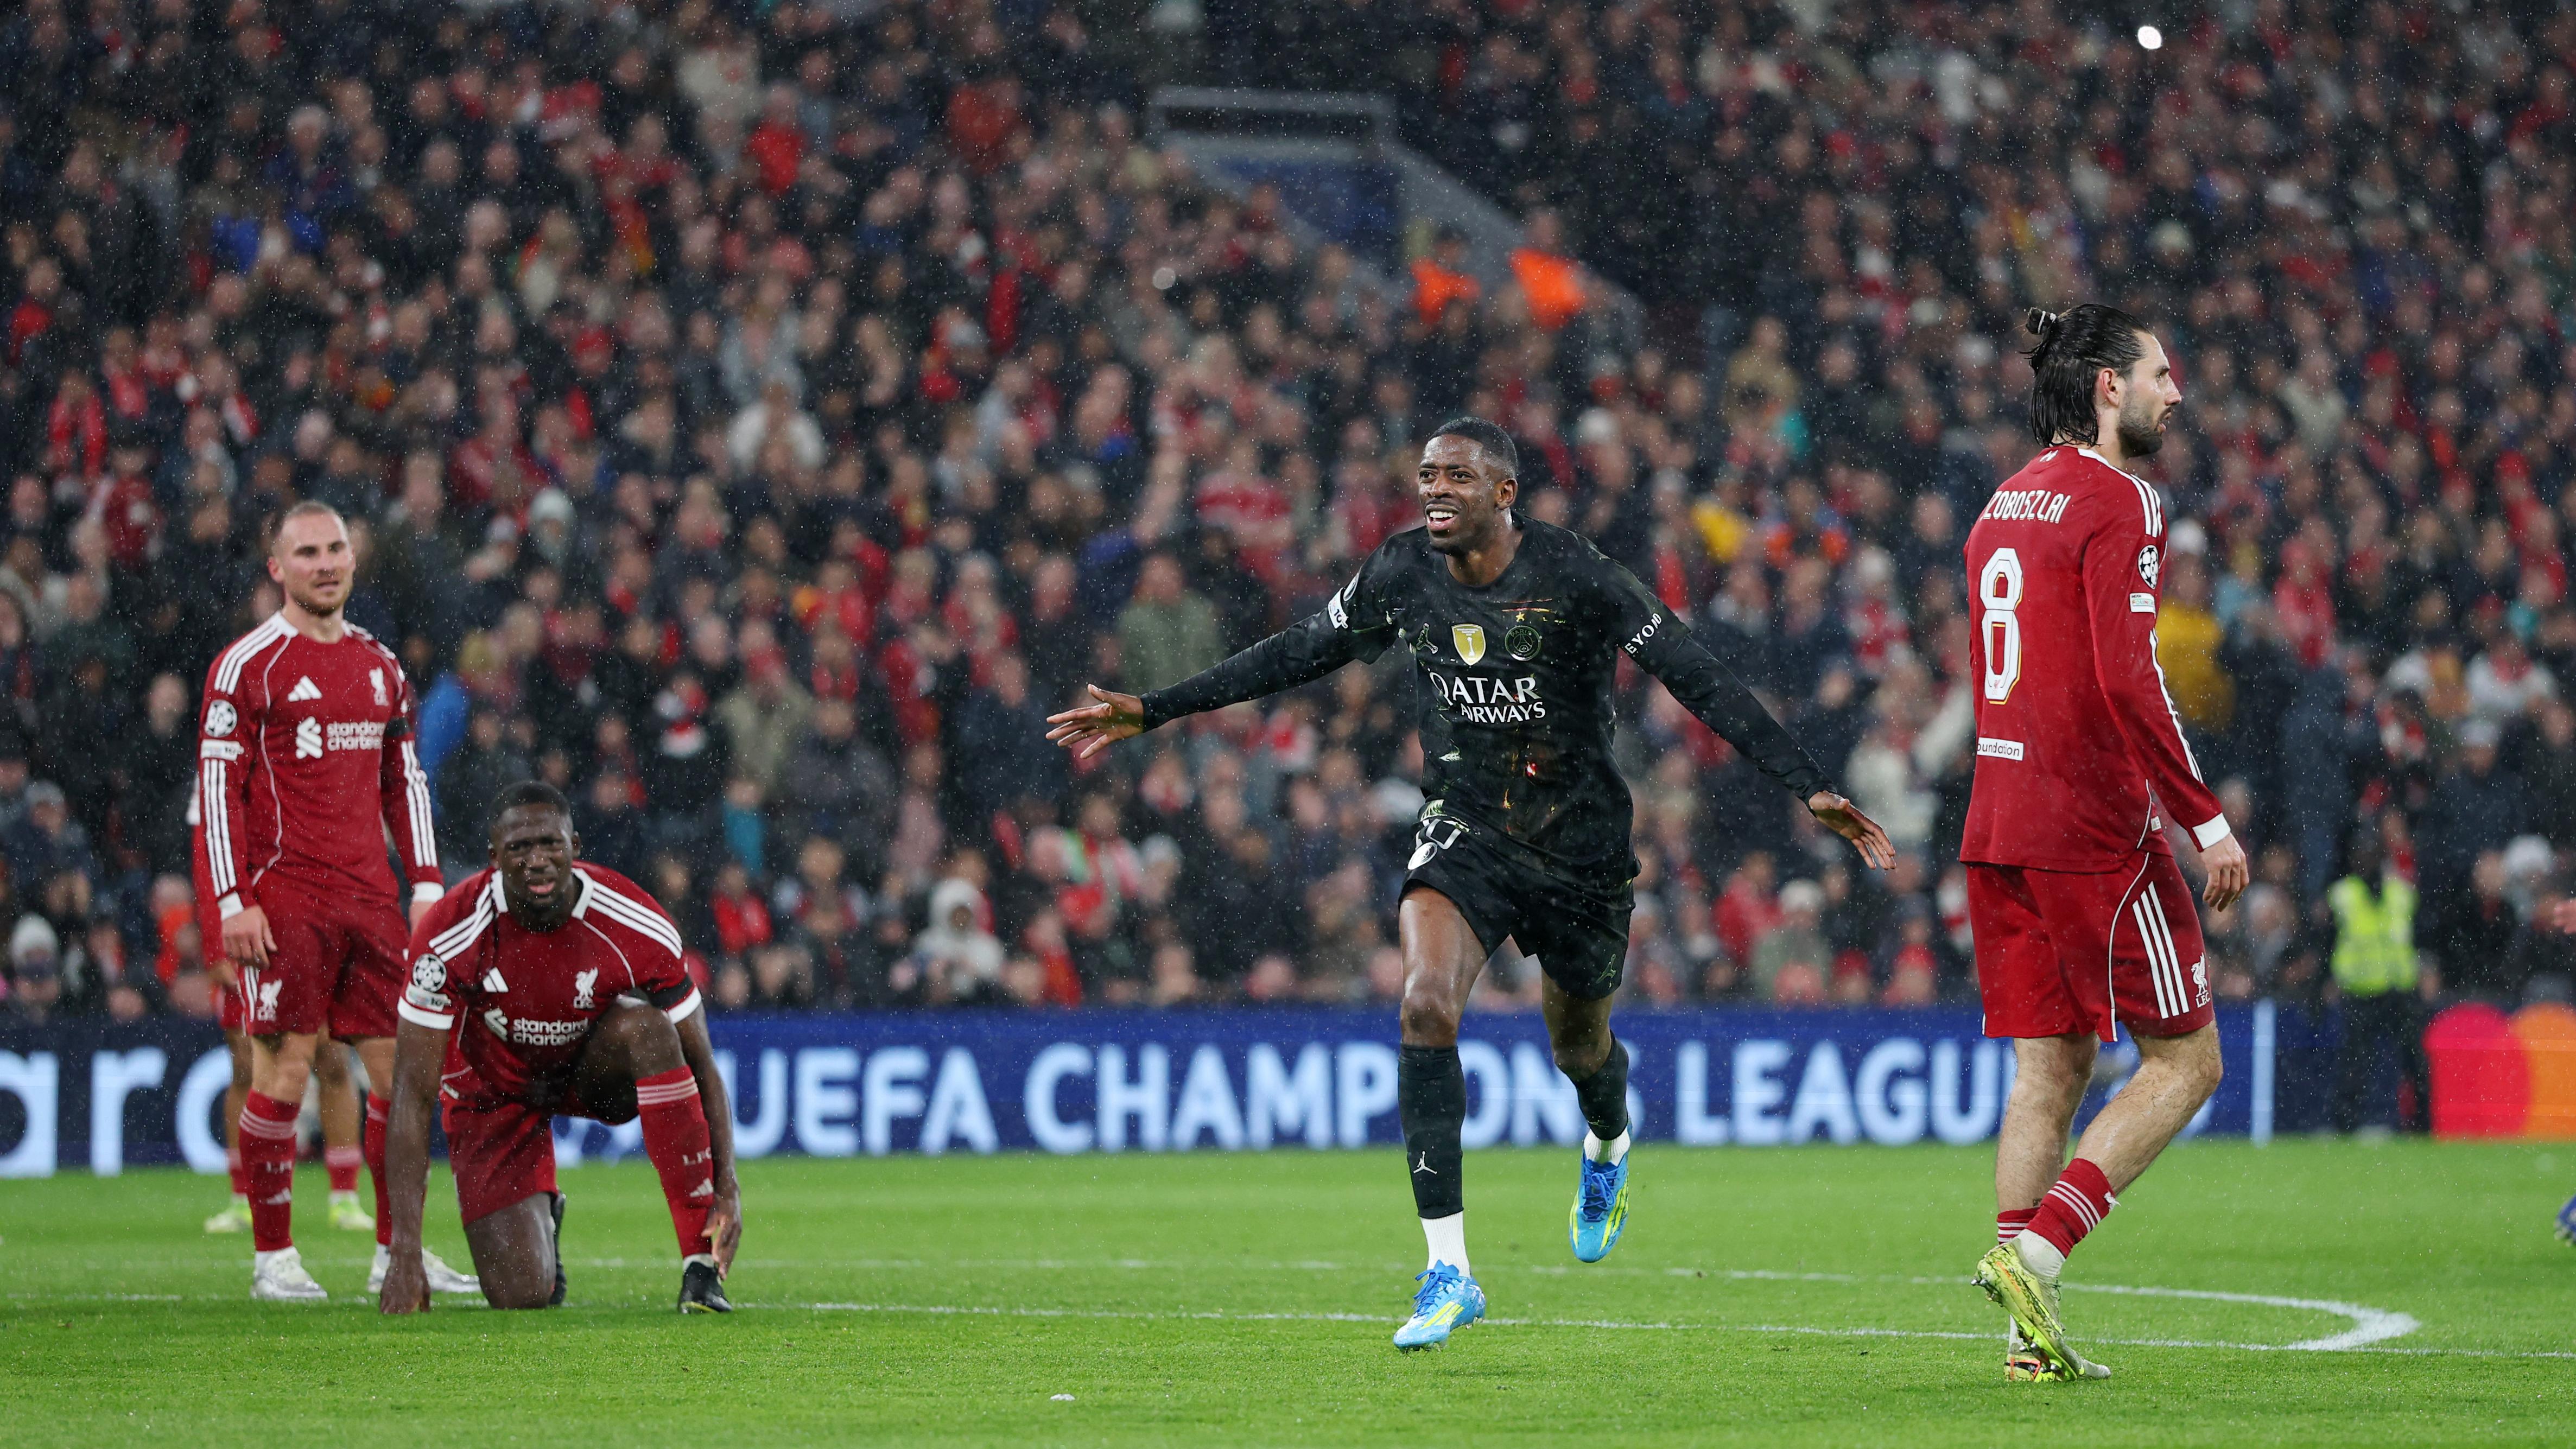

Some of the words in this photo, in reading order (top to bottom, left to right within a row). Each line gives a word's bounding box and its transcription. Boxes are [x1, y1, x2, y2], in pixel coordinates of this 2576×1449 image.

[1980, 490, 2072, 524] ZOBOSZLAI
[1979, 547, 2024, 705] 8
[1429, 672, 1542, 706] QATAR
[1460, 701, 1546, 723] AIRWAYS
[713, 1045, 999, 1158] UEFA
[1023, 1040, 1645, 1155] CHAMPON
[1675, 1035, 2017, 1148] LEAGU
